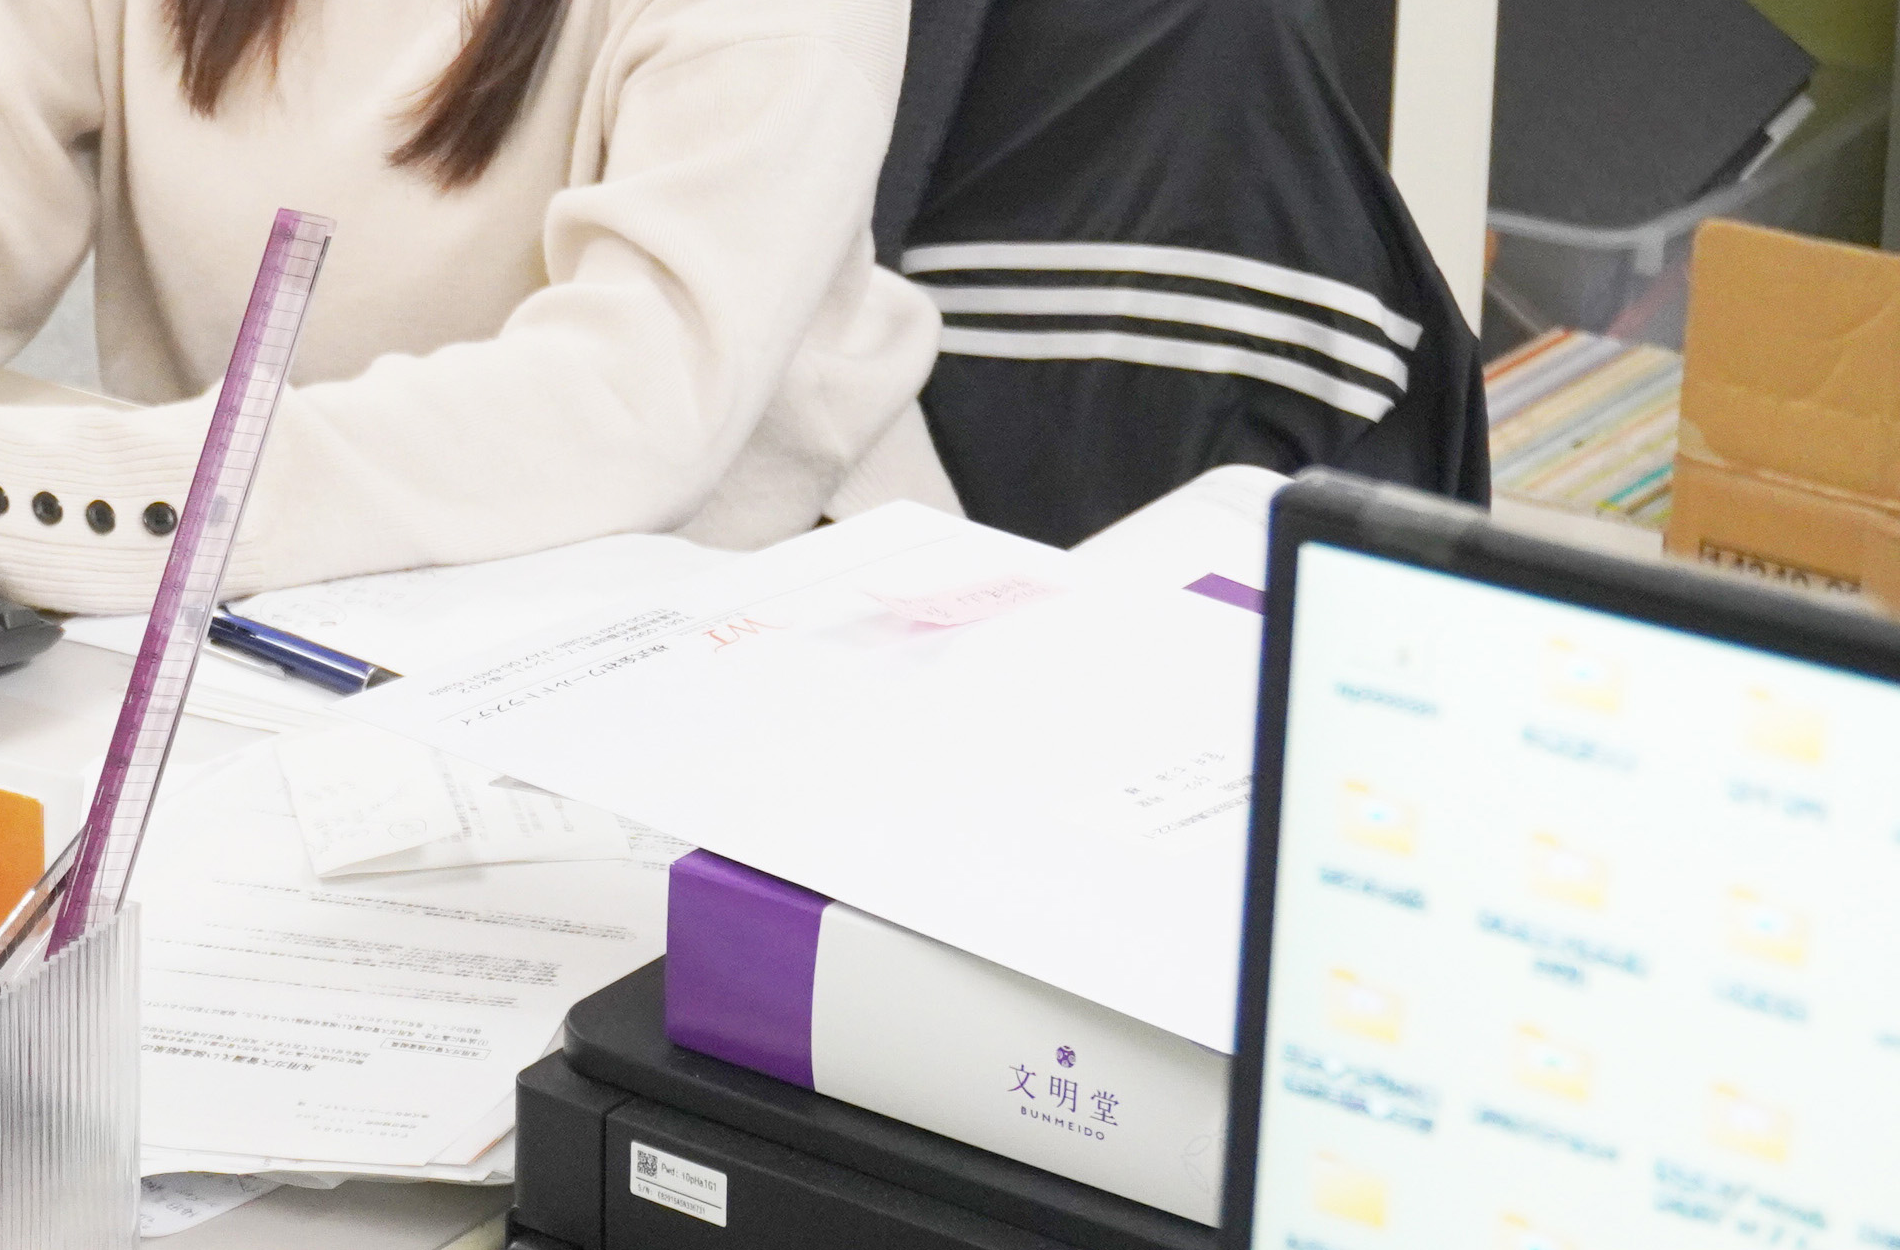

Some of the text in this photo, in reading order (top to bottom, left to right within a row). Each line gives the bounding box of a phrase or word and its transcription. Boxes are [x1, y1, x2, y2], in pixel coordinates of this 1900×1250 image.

[459, 643, 671, 727] 株式会社ワールドトラスティ
[1006, 1064, 1120, 1127] 文明堂
[1020, 1106, 1105, 1141] BUNMEIDO
